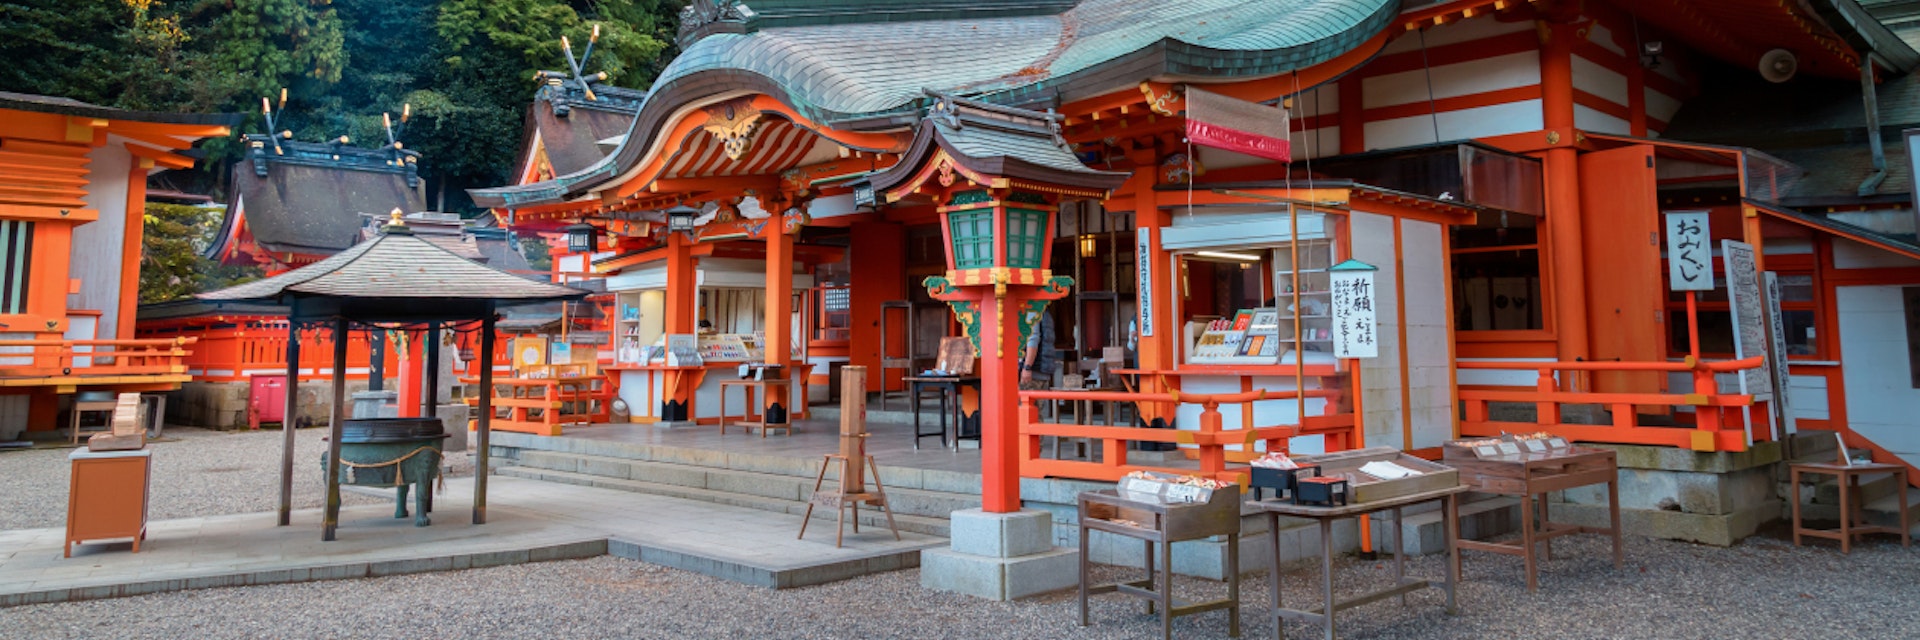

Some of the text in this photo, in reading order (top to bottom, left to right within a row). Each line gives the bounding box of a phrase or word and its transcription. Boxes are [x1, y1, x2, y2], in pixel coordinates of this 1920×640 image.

[1677, 219, 1704, 282] おみくじ
[1352, 278, 1371, 311] 祈願
